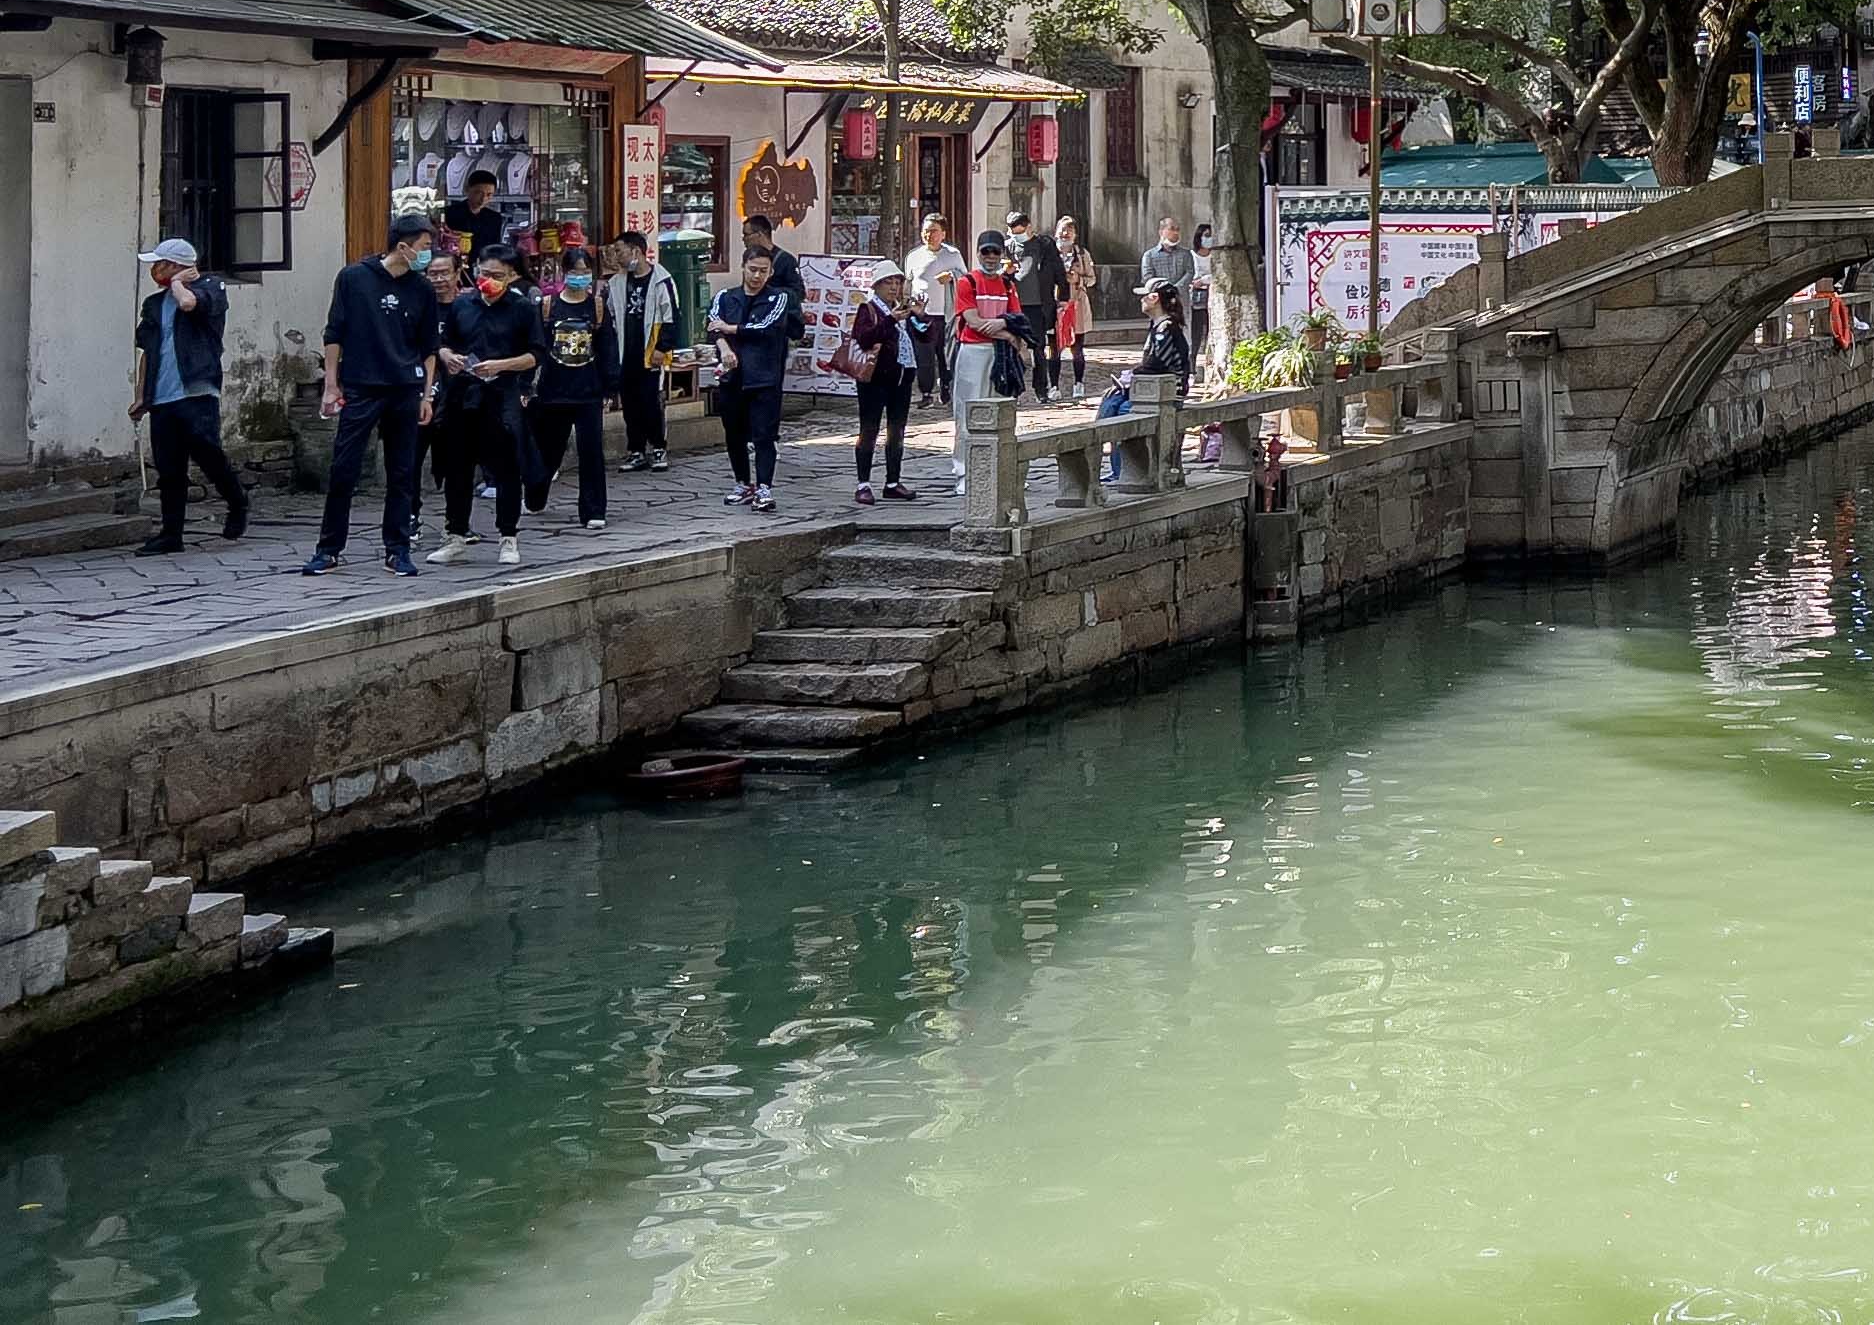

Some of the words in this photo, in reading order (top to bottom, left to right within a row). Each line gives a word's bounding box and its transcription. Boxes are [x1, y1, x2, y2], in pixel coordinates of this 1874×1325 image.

[1795, 66, 1810, 121] 便利店
[1812, 74, 1826, 112] 客房
